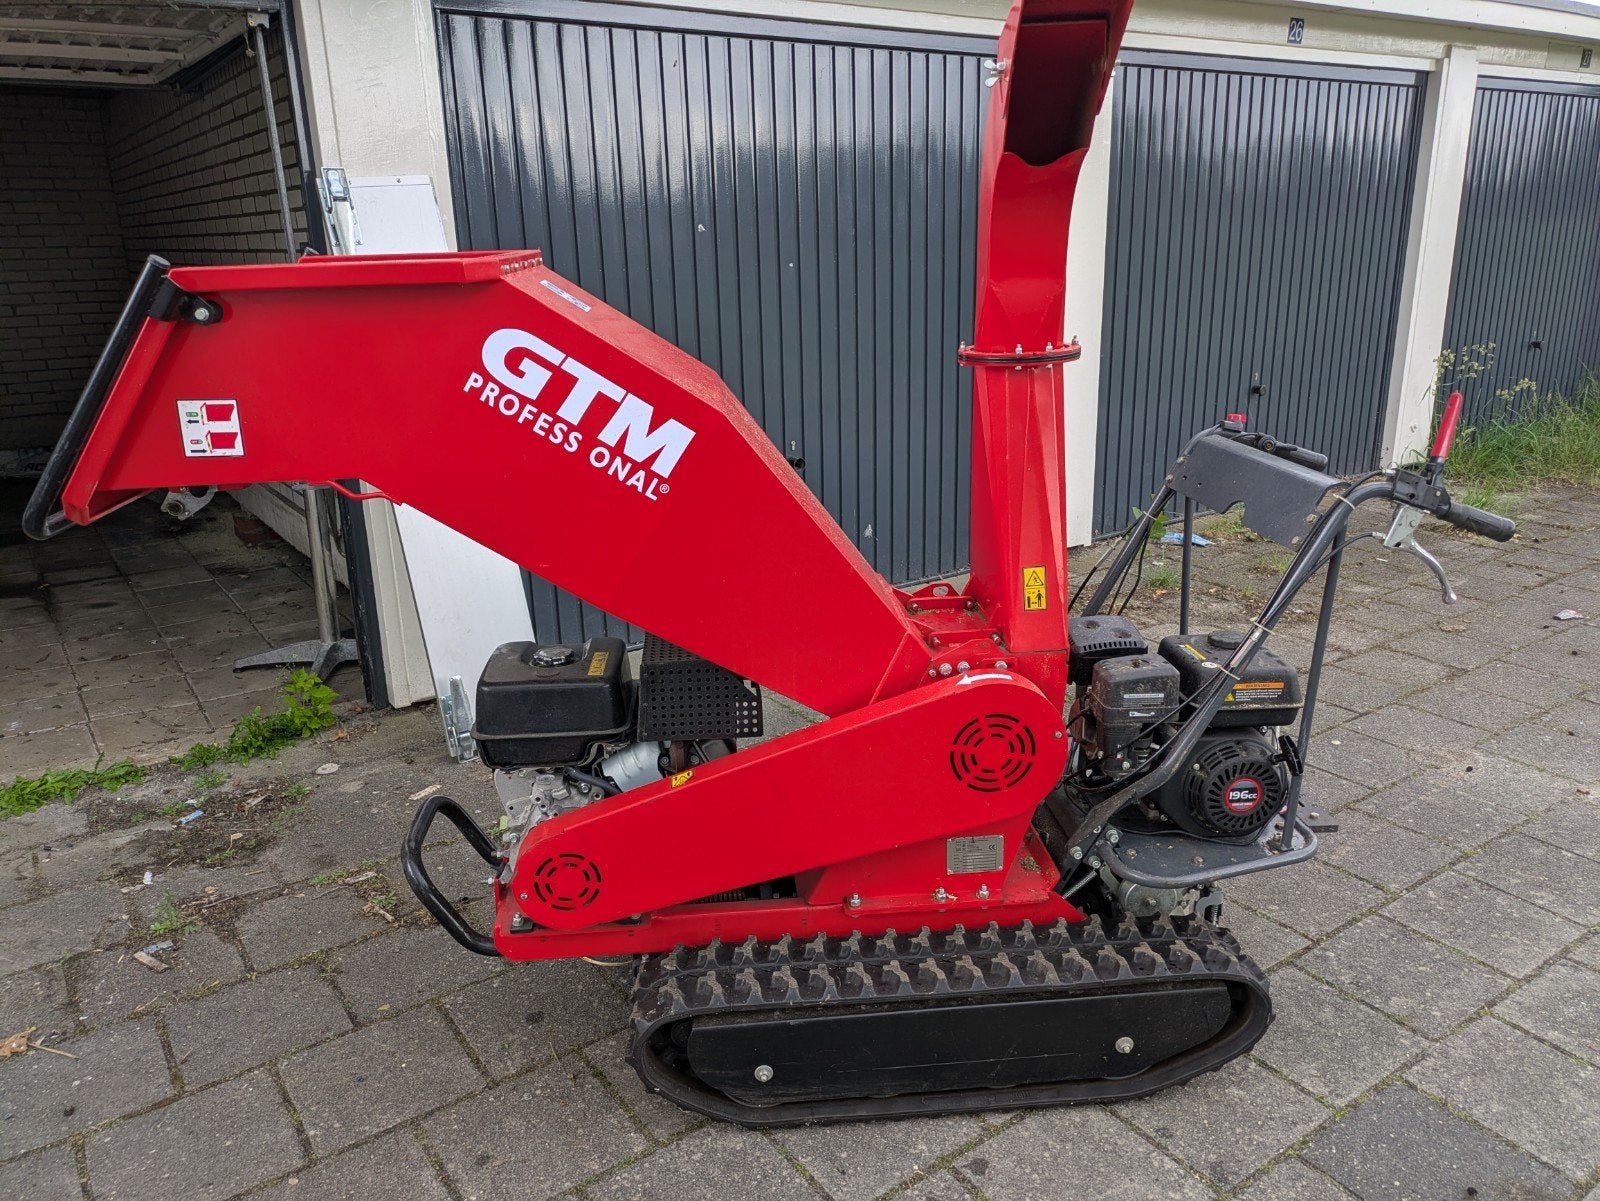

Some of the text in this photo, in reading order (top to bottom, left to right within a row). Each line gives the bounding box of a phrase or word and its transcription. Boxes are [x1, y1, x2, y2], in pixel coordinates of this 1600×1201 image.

[1289, 20, 1303, 42] 26
[481, 328, 697, 479] GTM
[1229, 790, 1258, 800] 196cc
